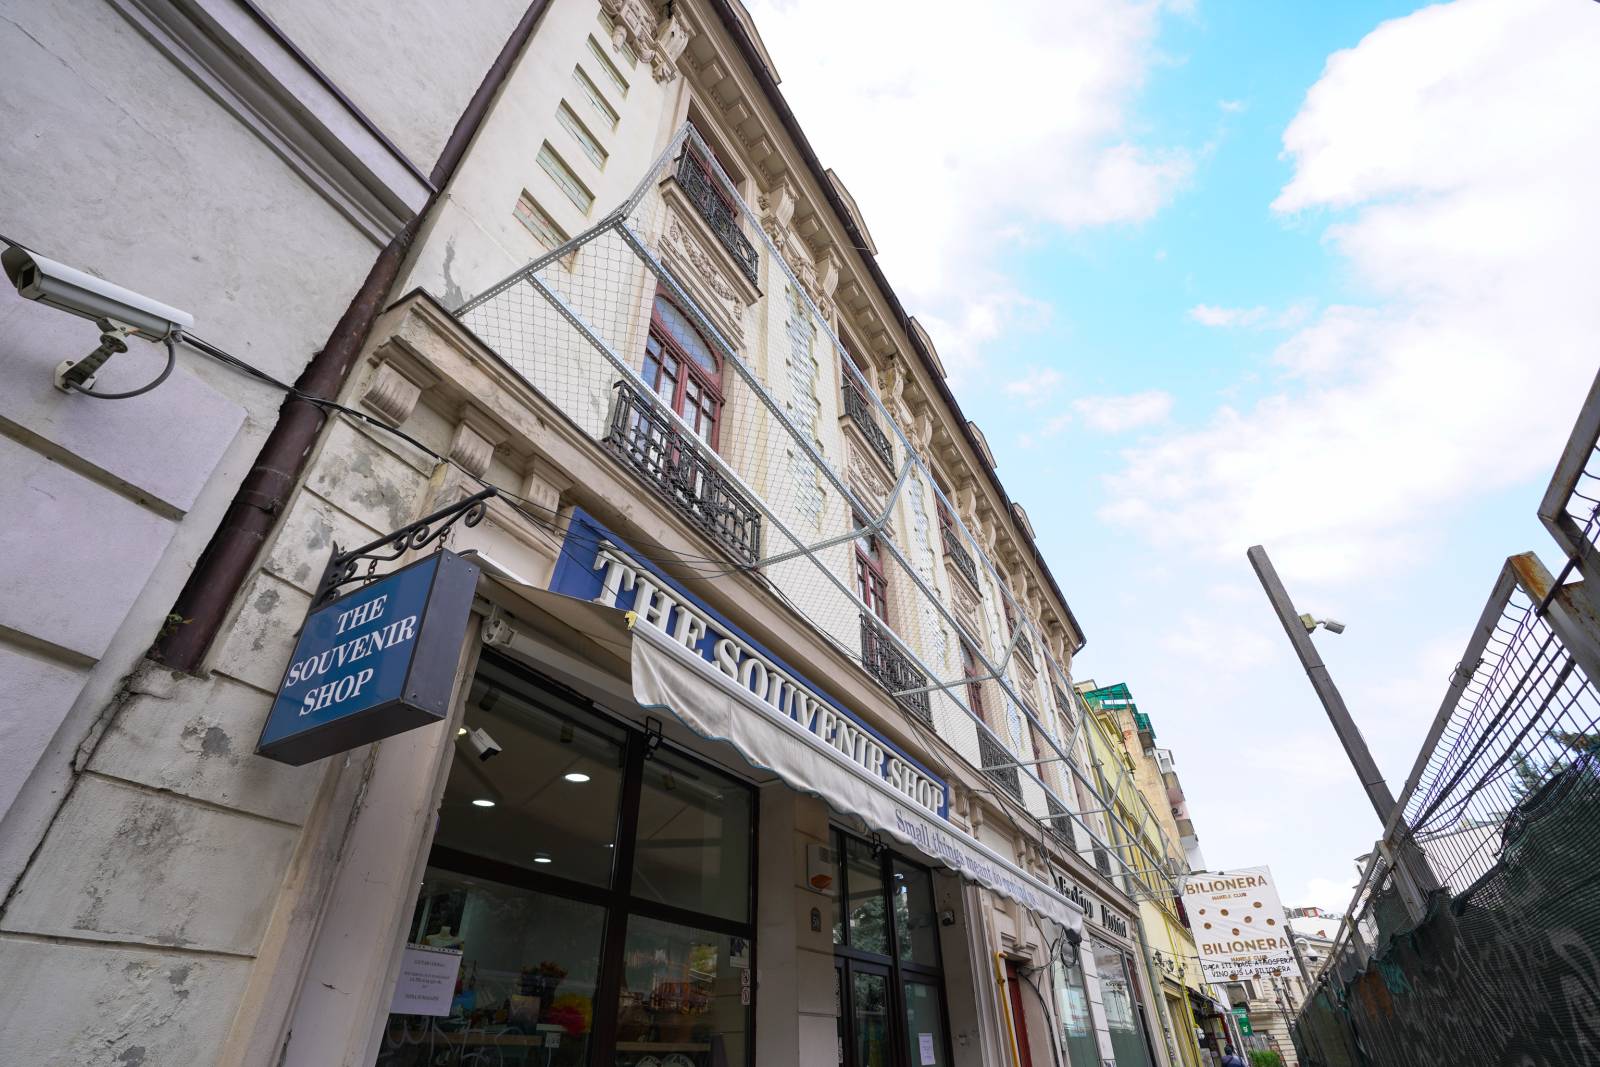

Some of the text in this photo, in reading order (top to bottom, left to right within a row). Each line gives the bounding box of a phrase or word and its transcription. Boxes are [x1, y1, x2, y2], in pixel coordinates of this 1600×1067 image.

[336, 594, 387, 636] THE
[285, 615, 417, 688] SOUVENIR
[298, 667, 374, 717] SHOP
[593, 549, 944, 817] THE SOUVENIR SHOP
[895, 809, 931, 849] Small
[932, 834, 964, 868] things
[1185, 875, 1268, 895] BILIONERA
[1202, 936, 1289, 955] BILIONERA
[1211, 970, 1229, 978] VINO
[1231, 968, 1243, 976] SUS
[1255, 965, 1291, 975] BILIONERA
